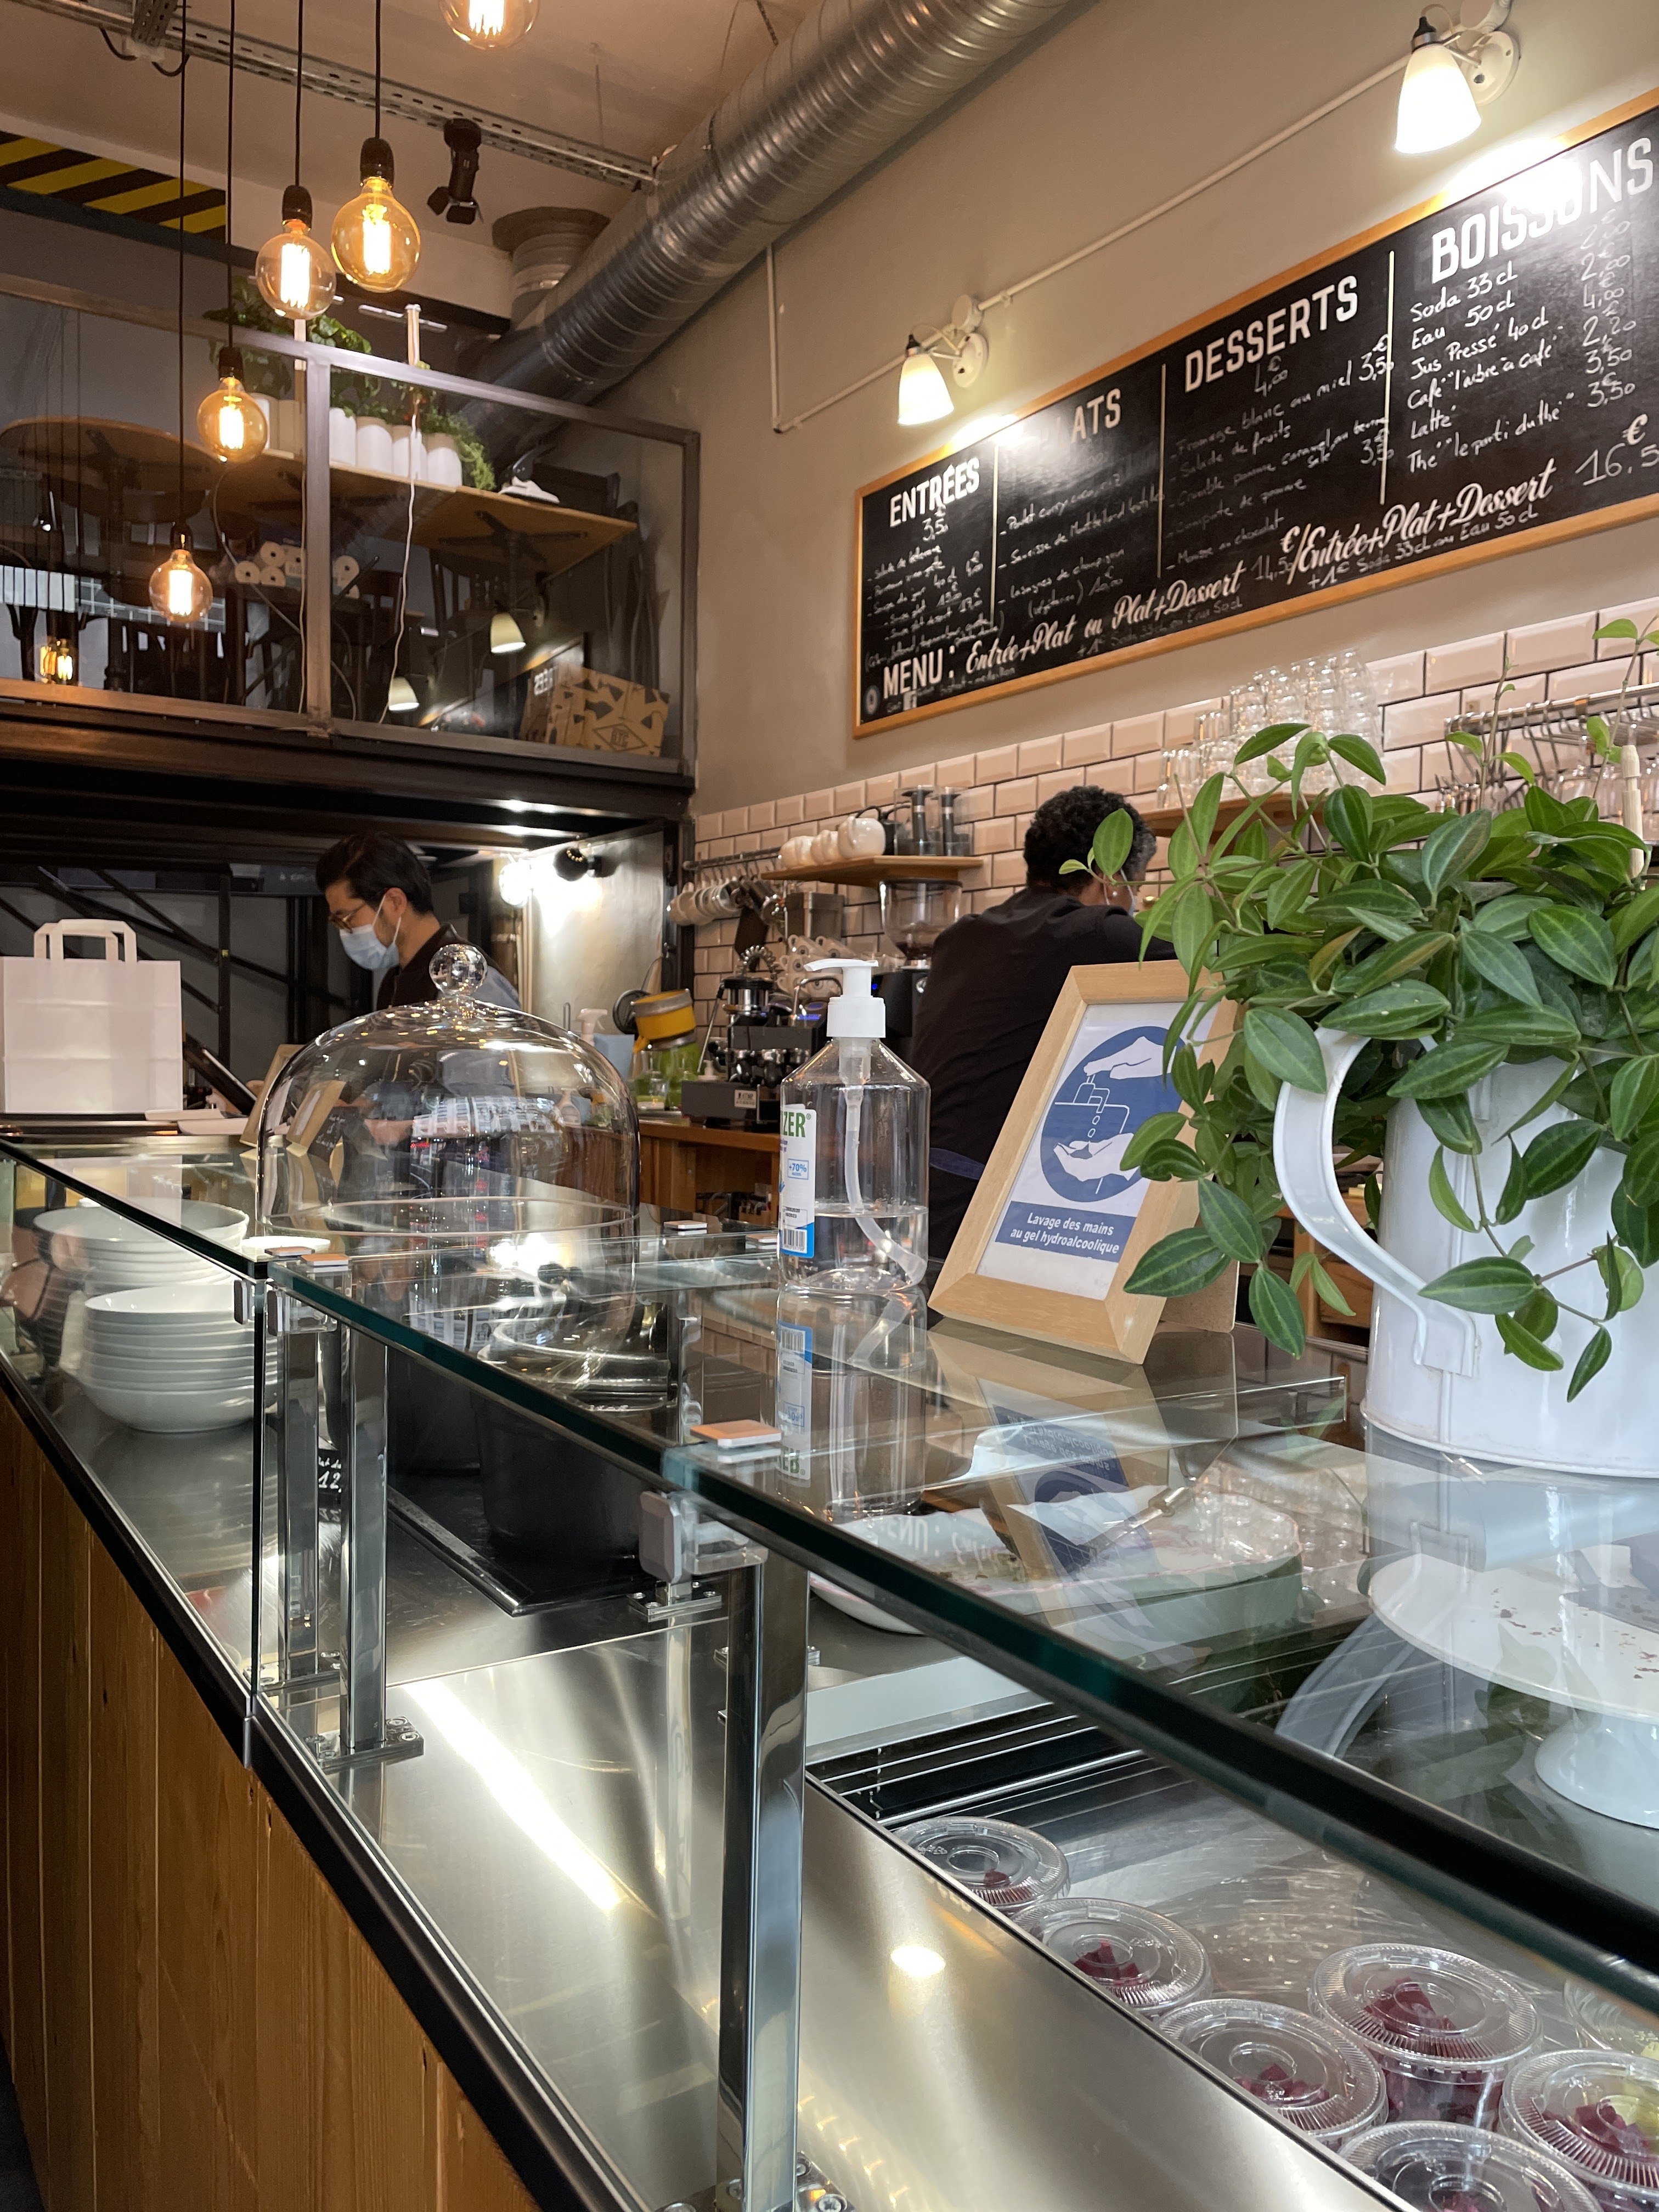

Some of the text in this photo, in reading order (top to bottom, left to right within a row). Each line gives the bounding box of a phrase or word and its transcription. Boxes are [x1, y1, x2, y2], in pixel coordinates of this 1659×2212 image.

[1410, 286, 1460, 321] Soda
[1186, 276, 1357, 390] DESSERTS
[1412, 327, 1445, 349] Eau
[1410, 357, 1441, 379] Jus
[1445, 323, 1499, 360] Pressé
[1242, 404, 1284, 429] blanc
[1290, 393, 1311, 407] au
[1317, 360, 1352, 396] miel
[1407, 377, 1446, 408] Café
[1252, 420, 1290, 454] fruits
[889, 457, 980, 528] ENTRÉES
[884, 649, 942, 698] MENU
[1084, 619, 1102, 637] ou
[1011, 1228, 1119, 1255] au gel hydroalcoolique
[1027, 1212, 1114, 1236] Lavage des mains
